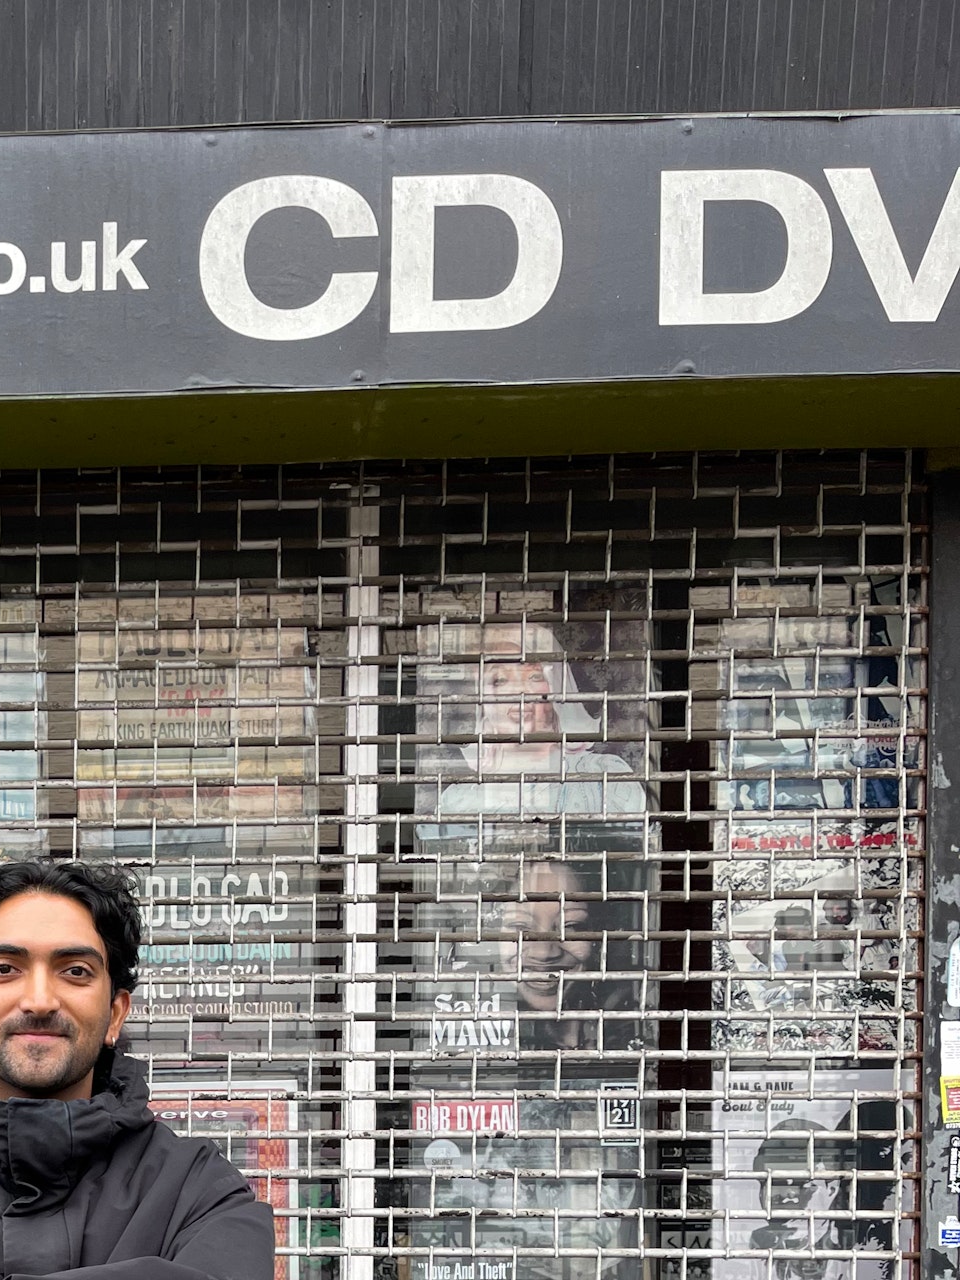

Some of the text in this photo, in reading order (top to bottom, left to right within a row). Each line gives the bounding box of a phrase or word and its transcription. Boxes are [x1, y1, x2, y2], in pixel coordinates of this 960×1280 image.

[198, 166, 960, 342] CD DV
[611, 1107, 630, 1123] 21
[721, 1100, 795, 1116] Soul Sudy
[415, 1104, 515, 1131] BOB DYLAN
[454, 1262, 475, 1280] And
